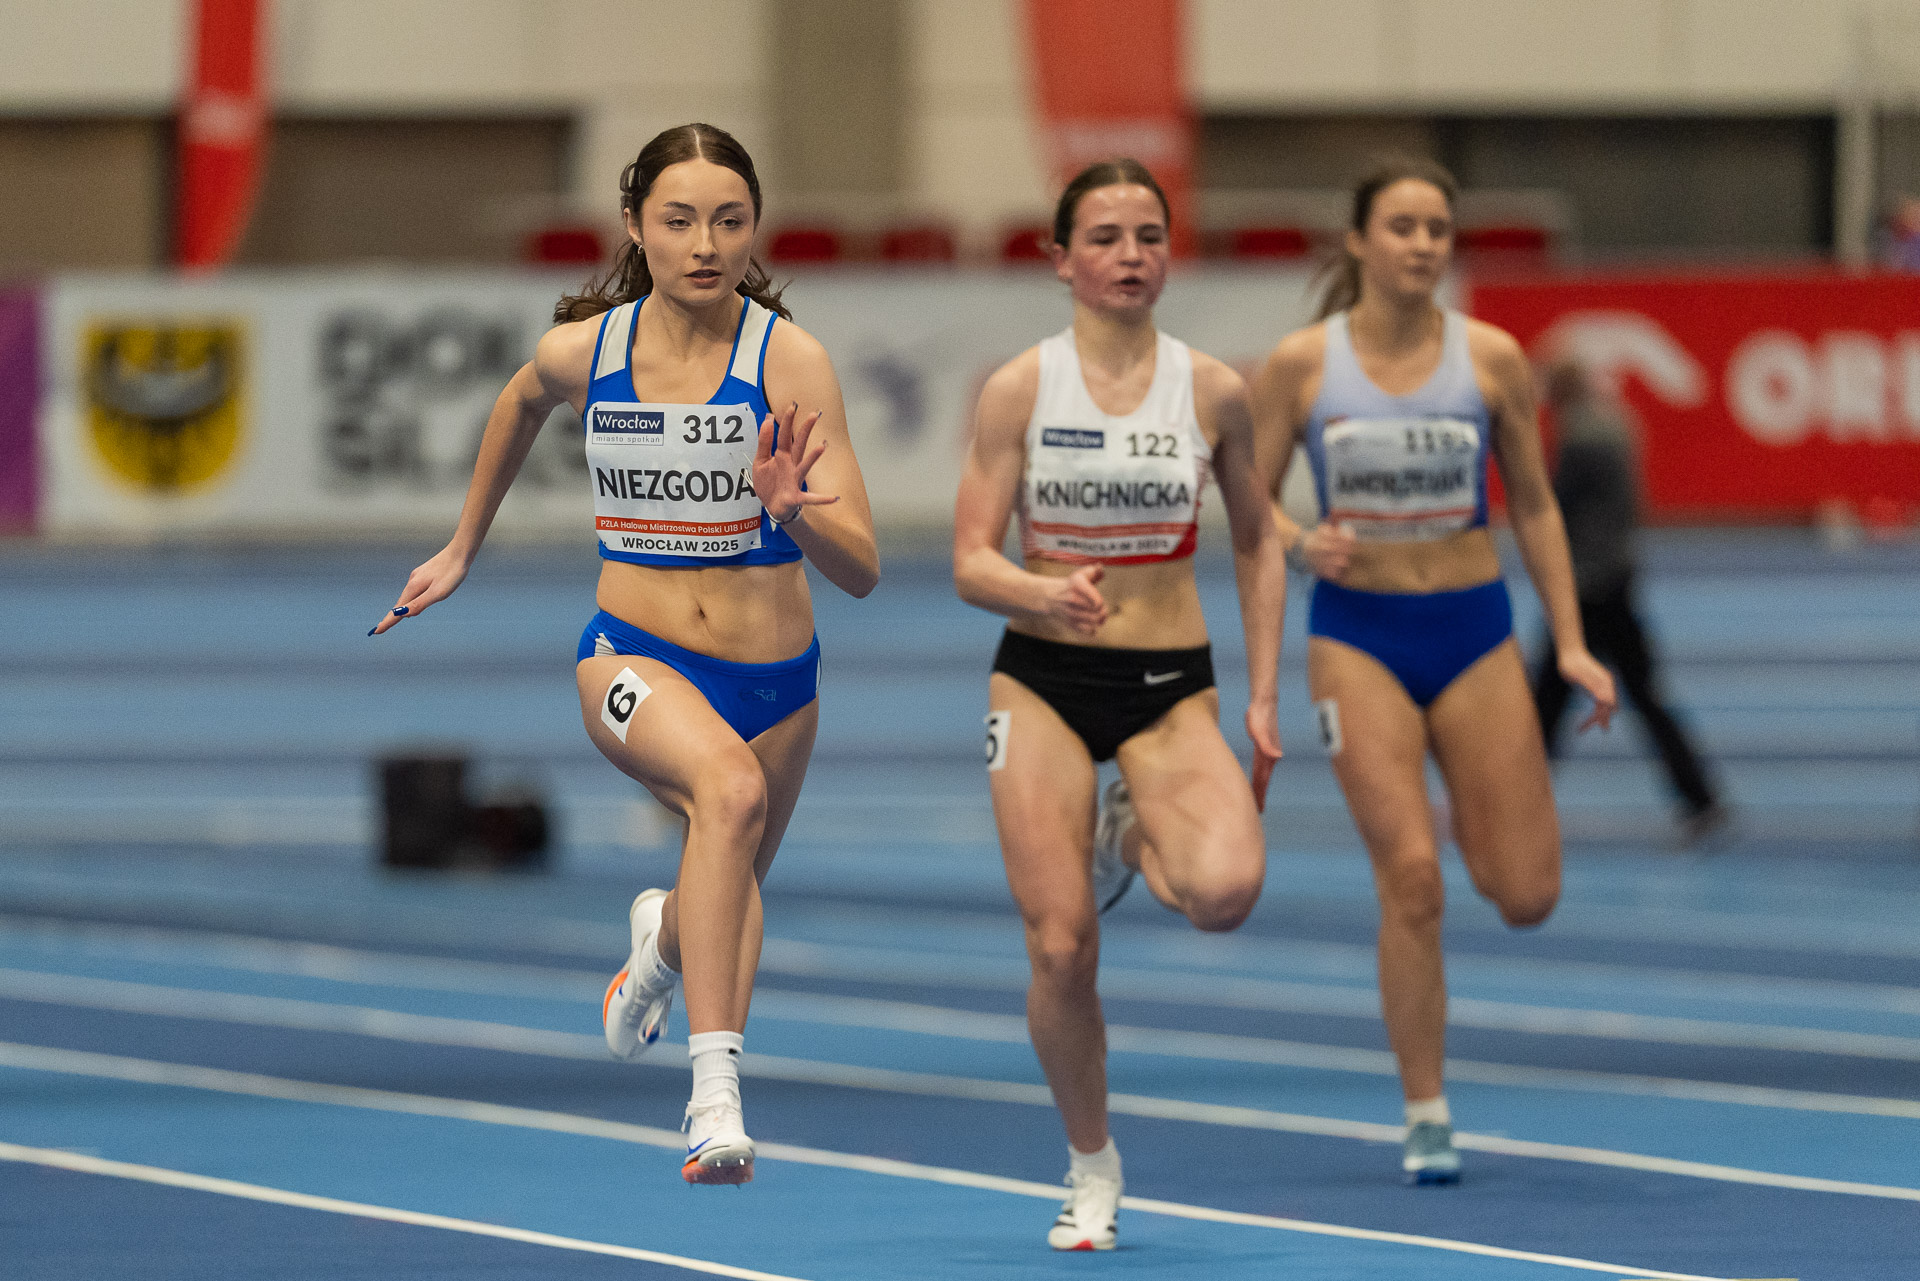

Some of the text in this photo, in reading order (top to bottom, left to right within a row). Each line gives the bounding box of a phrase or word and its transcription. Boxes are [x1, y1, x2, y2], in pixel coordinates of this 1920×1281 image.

[596, 414, 661, 430] Wrocław
[683, 414, 744, 444] 312
[595, 435, 624, 443] miasto
[1128, 433, 1178, 458] 122
[596, 467, 757, 503] NIEZGODA
[1037, 479, 1190, 509] KNICHNICKA
[600, 520, 619, 529] PZLA
[620, 521, 648, 531] Halowe
[649, 523, 697, 534] Mistrzostwa
[698, 525, 723, 534] Polski
[723, 525, 739, 533] U18
[744, 519, 758, 530] U20
[622, 536, 739, 552] WROCŁAW 2025
[607, 682, 637, 724] 6
